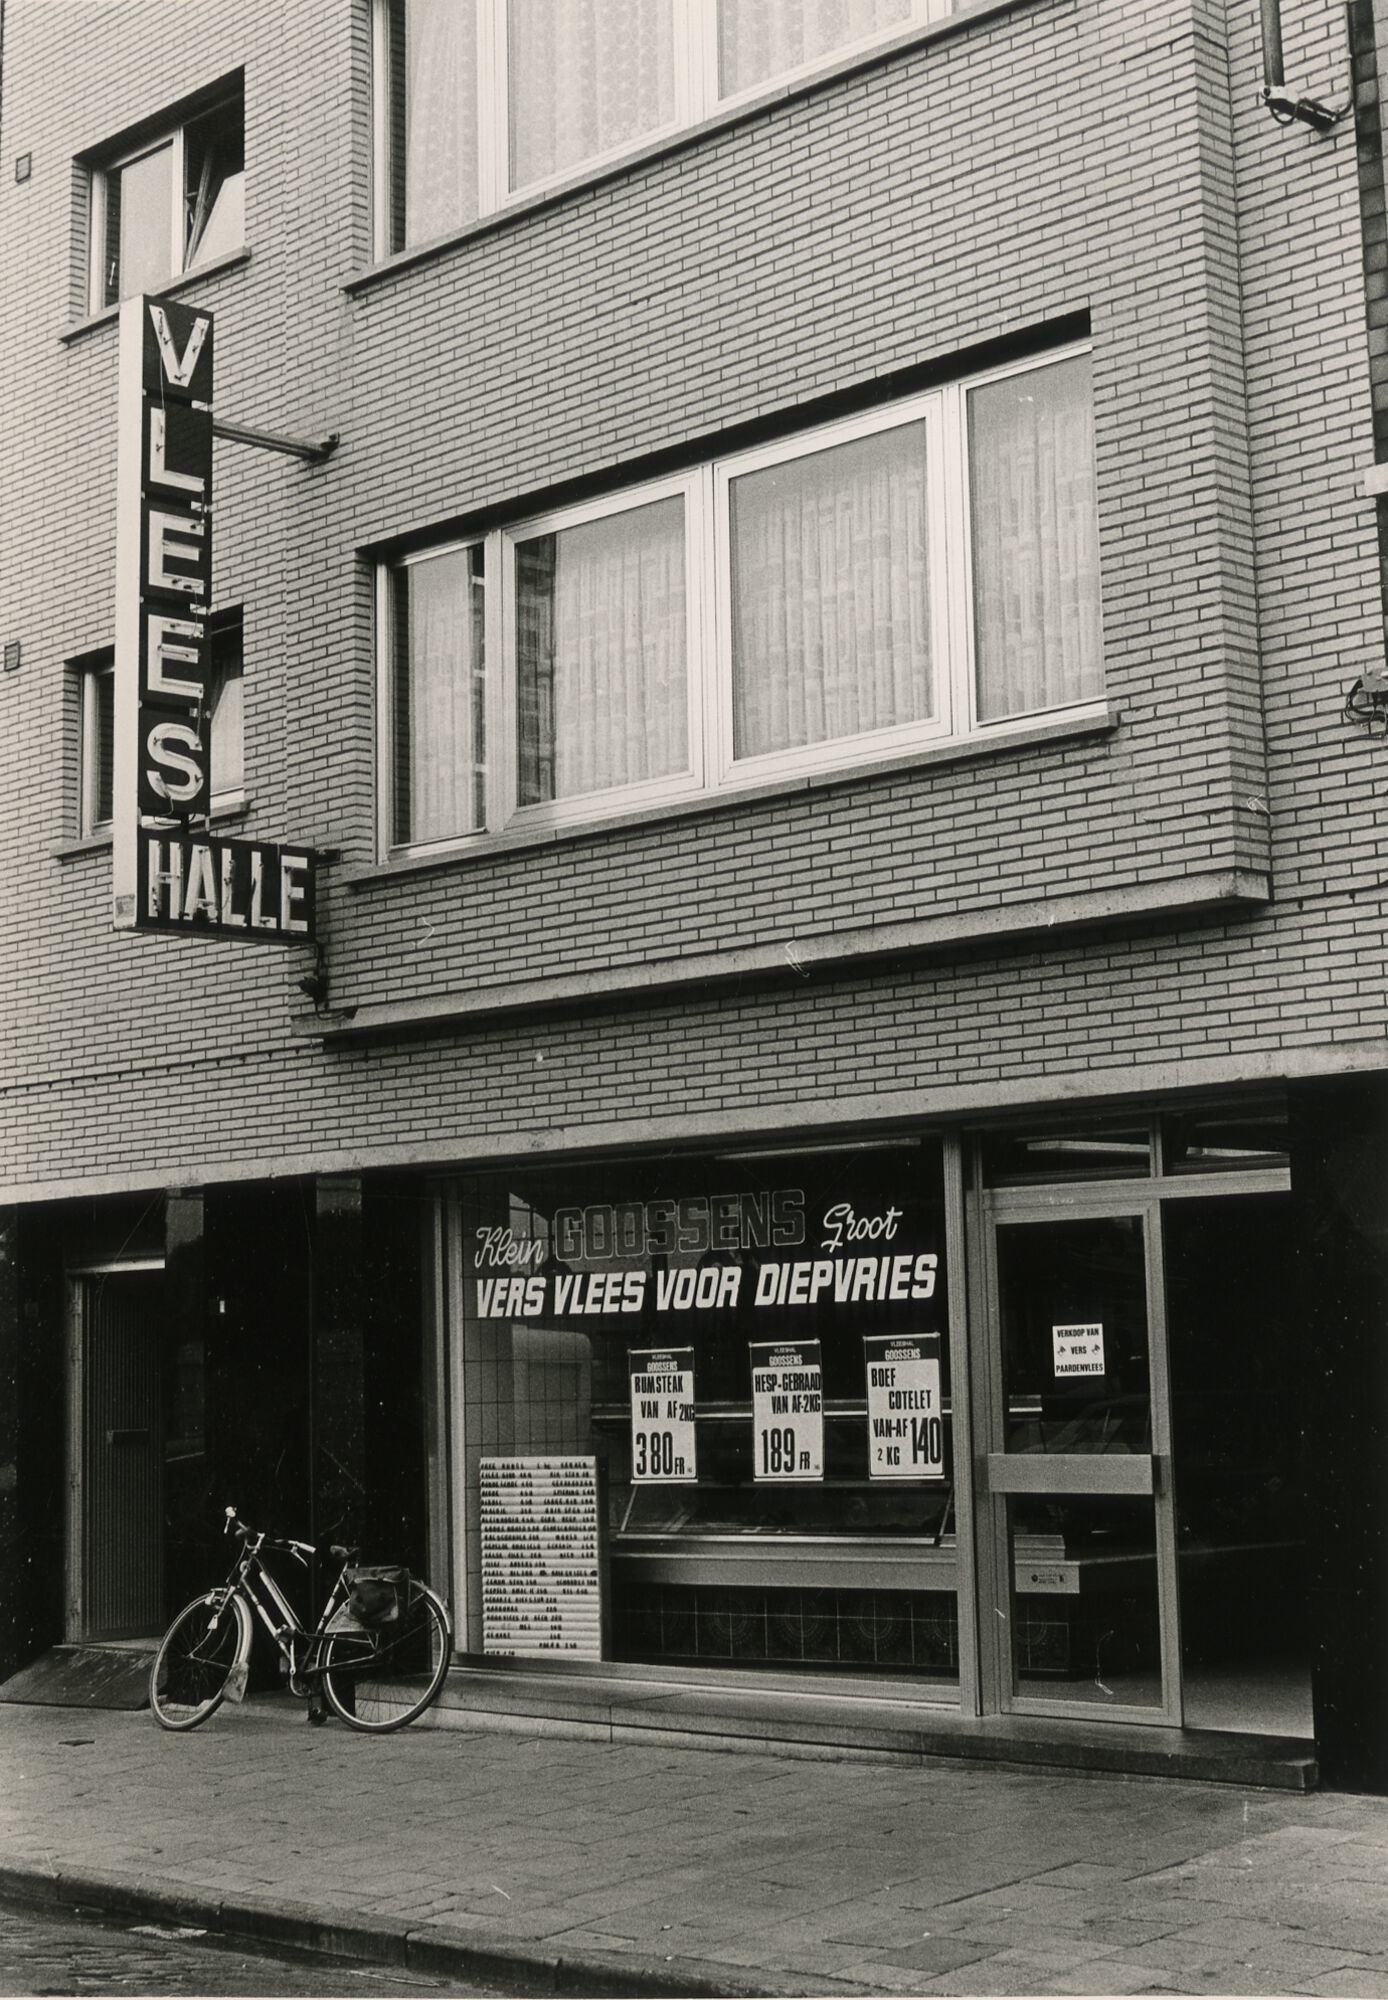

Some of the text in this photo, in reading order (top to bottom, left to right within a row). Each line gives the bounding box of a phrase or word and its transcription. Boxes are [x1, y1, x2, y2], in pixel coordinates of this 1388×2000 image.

[146, 305, 209, 803] VLEES
[147, 838, 309, 933] HALLE
[474, 1188, 904, 1269] Klein GOOSSENS Groot
[476, 1252, 939, 1319] VERS VLEES VOOR DIEPVRIES
[1057, 1327, 1099, 1338] VERKOOP VAN
[768, 1354, 803, 1367] GOOSSENS
[885, 1348, 921, 1361] GOOSSENS
[1070, 1346, 1087, 1355] VERS
[647, 1361, 678, 1373] GOOSSENS
[871, 1367, 896, 1387] BOEF
[1055, 1363, 1104, 1373] PAARDENVLEES
[635, 1374, 684, 1394] RUMSTEAK
[755, 1372, 821, 1393] HESP-GEBRAAD
[640, 1400, 659, 1419] VAN
[667, 1400, 678, 1419] AF
[771, 1395, 789, 1414] VAN
[888, 1389, 932, 1410] COTELET
[761, 1427, 810, 1474] 189 FR
[910, 1416, 942, 1465] 140
[636, 1431, 685, 1475] 380 FR
[877, 1446, 900, 1466] 2 KG
